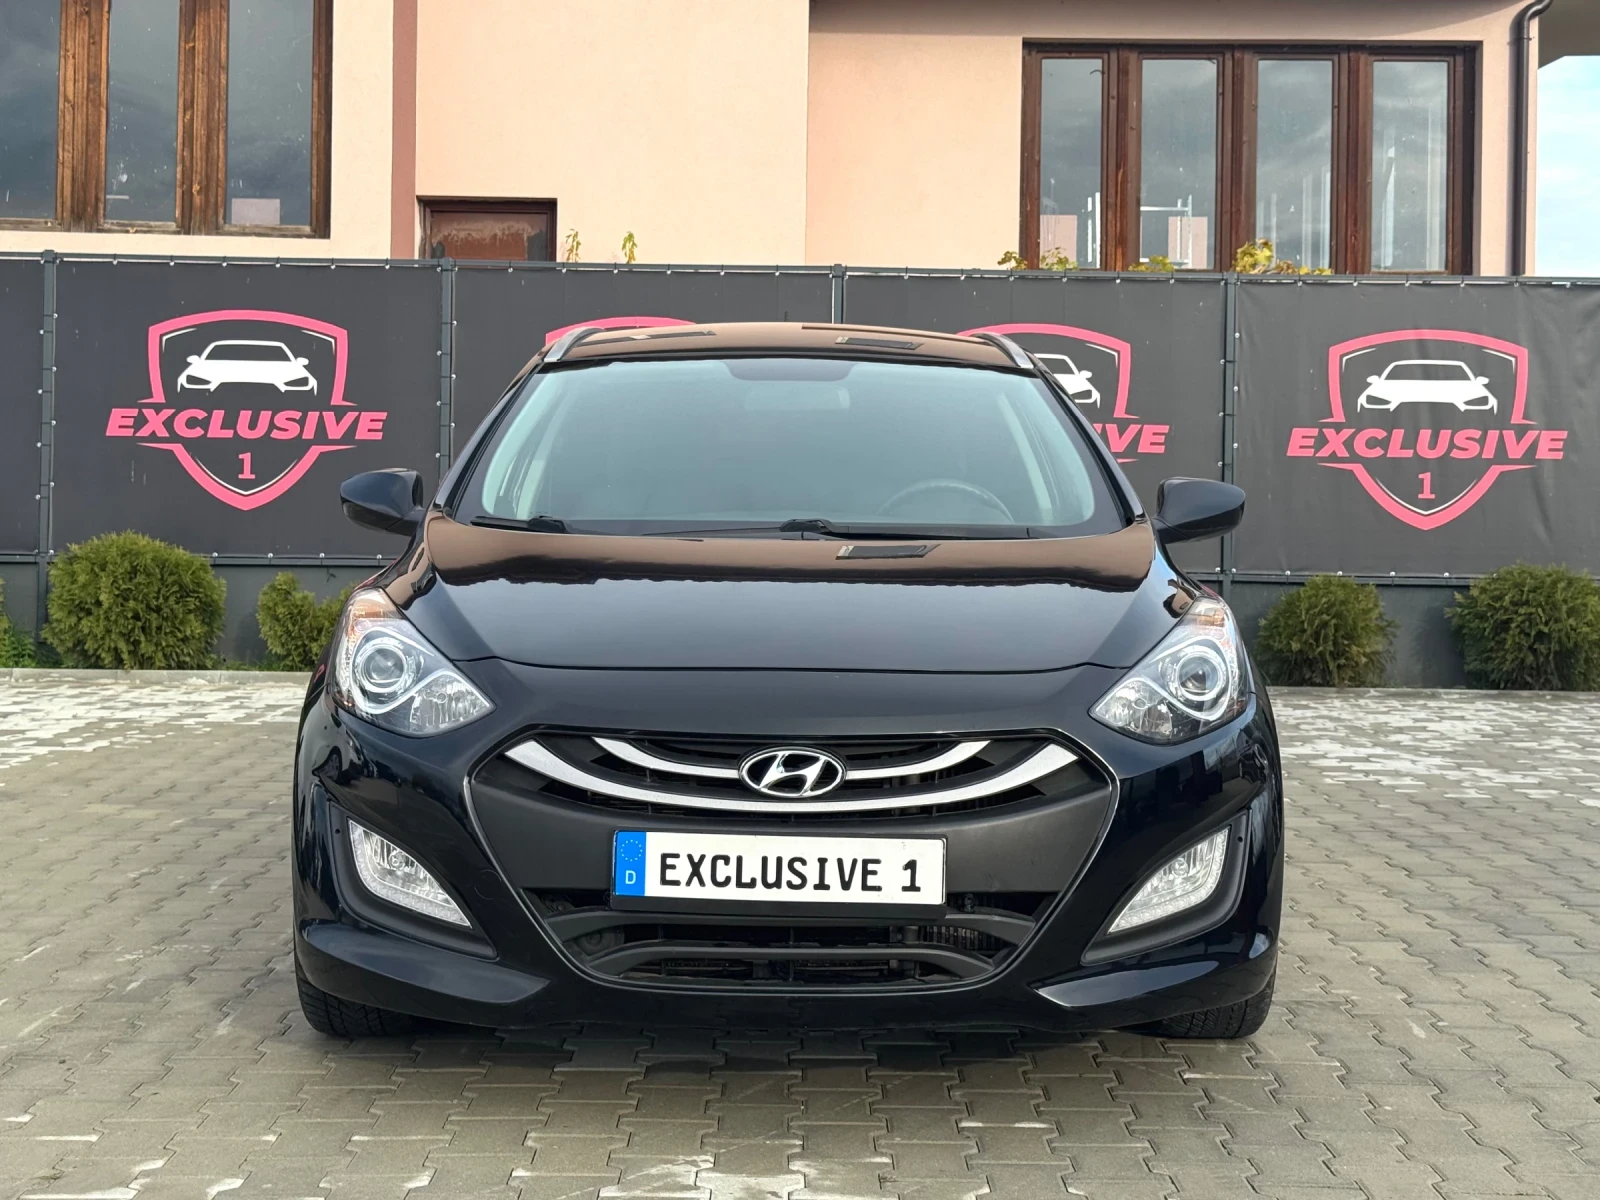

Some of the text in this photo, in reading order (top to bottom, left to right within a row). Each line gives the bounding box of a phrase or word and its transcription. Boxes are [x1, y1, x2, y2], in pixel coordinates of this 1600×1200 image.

[105, 408, 388, 440] EXCLUSIVE
[1286, 427, 1569, 460] EXCLUSIVE
[237, 452, 256, 480] 1
[1417, 472, 1436, 499] 1
[625, 869, 637, 885] D
[659, 852, 922, 893] EXCLUSIVE 1
